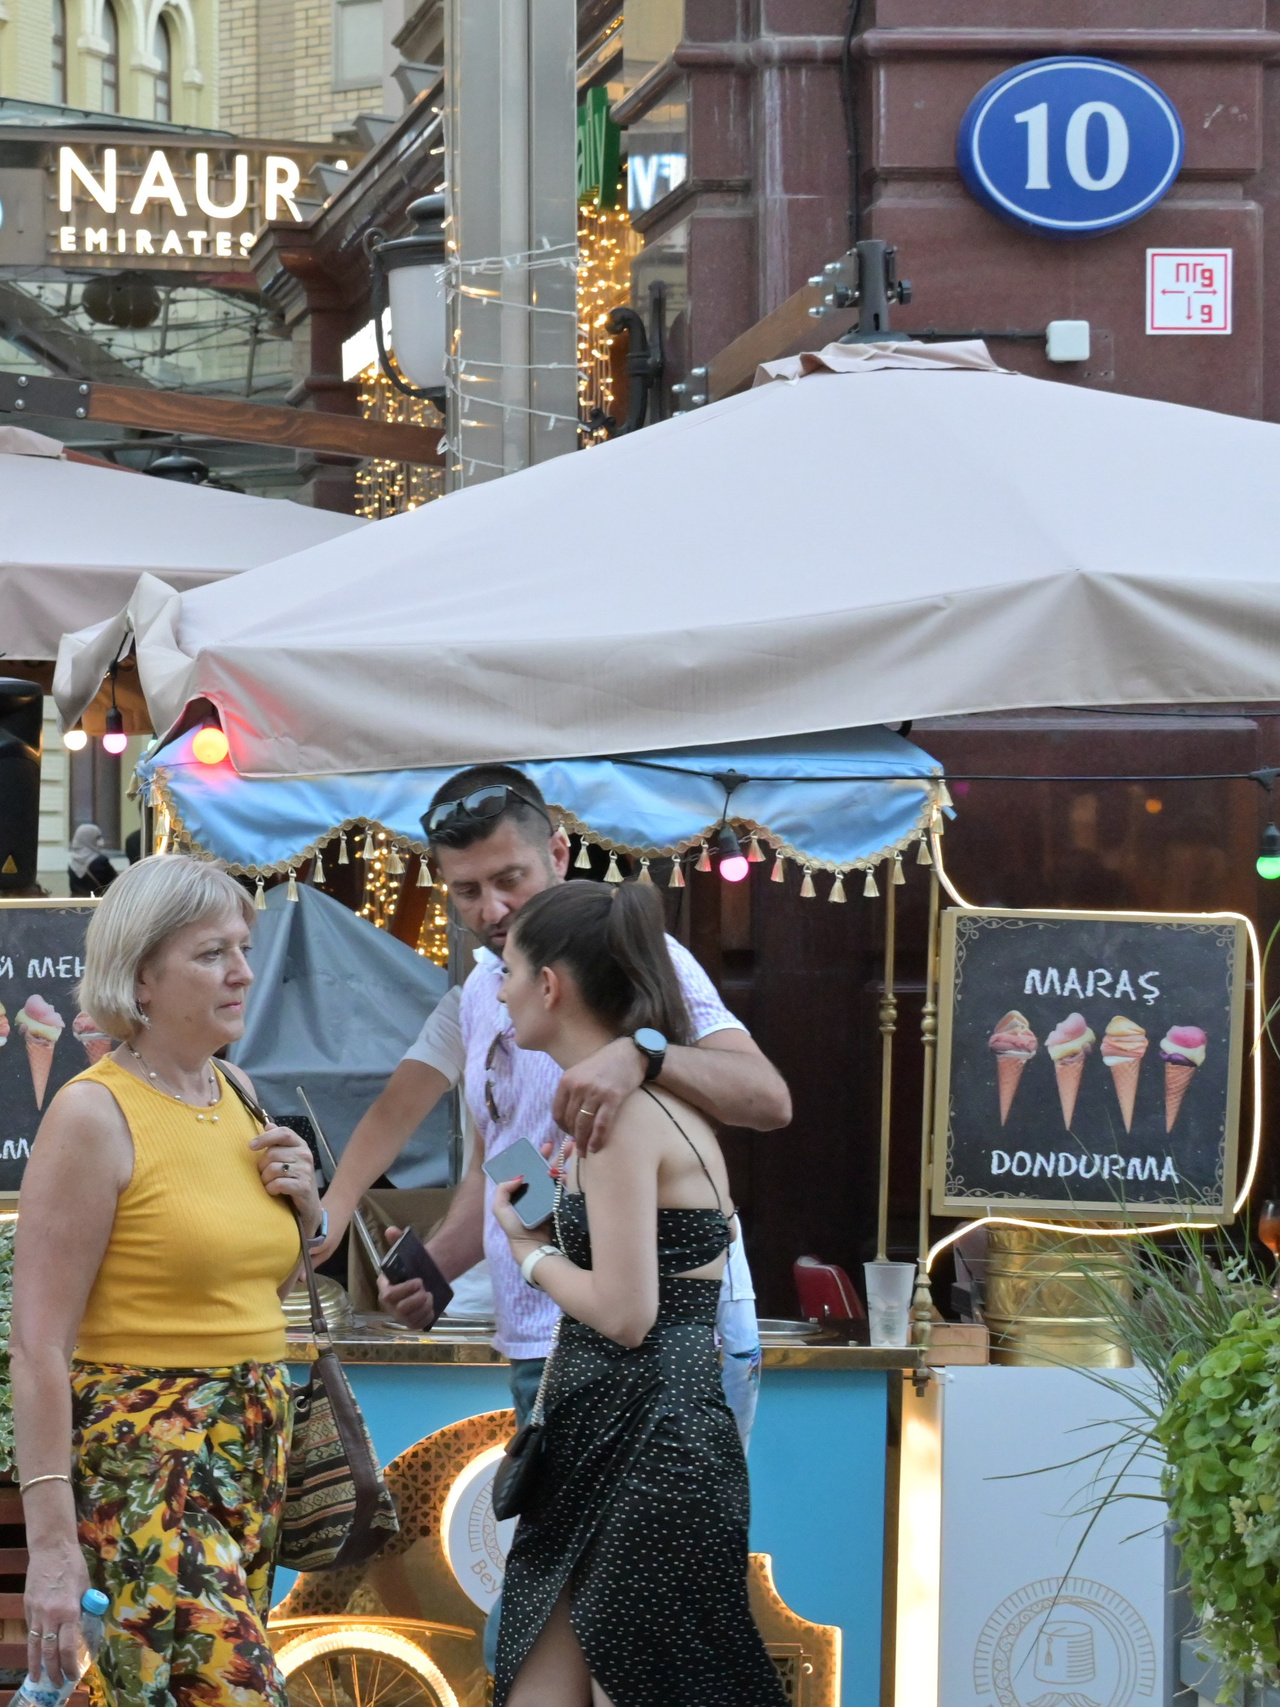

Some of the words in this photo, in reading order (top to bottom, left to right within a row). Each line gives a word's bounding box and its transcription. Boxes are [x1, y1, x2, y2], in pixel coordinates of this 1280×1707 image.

[1013, 101, 1131, 191] 10
[58, 146, 303, 222] NAUR
[59, 226, 256, 257] EMIRATES
[1024, 967, 1161, 1005] MARAŞ
[990, 1150, 1181, 1184] DONDURMA
